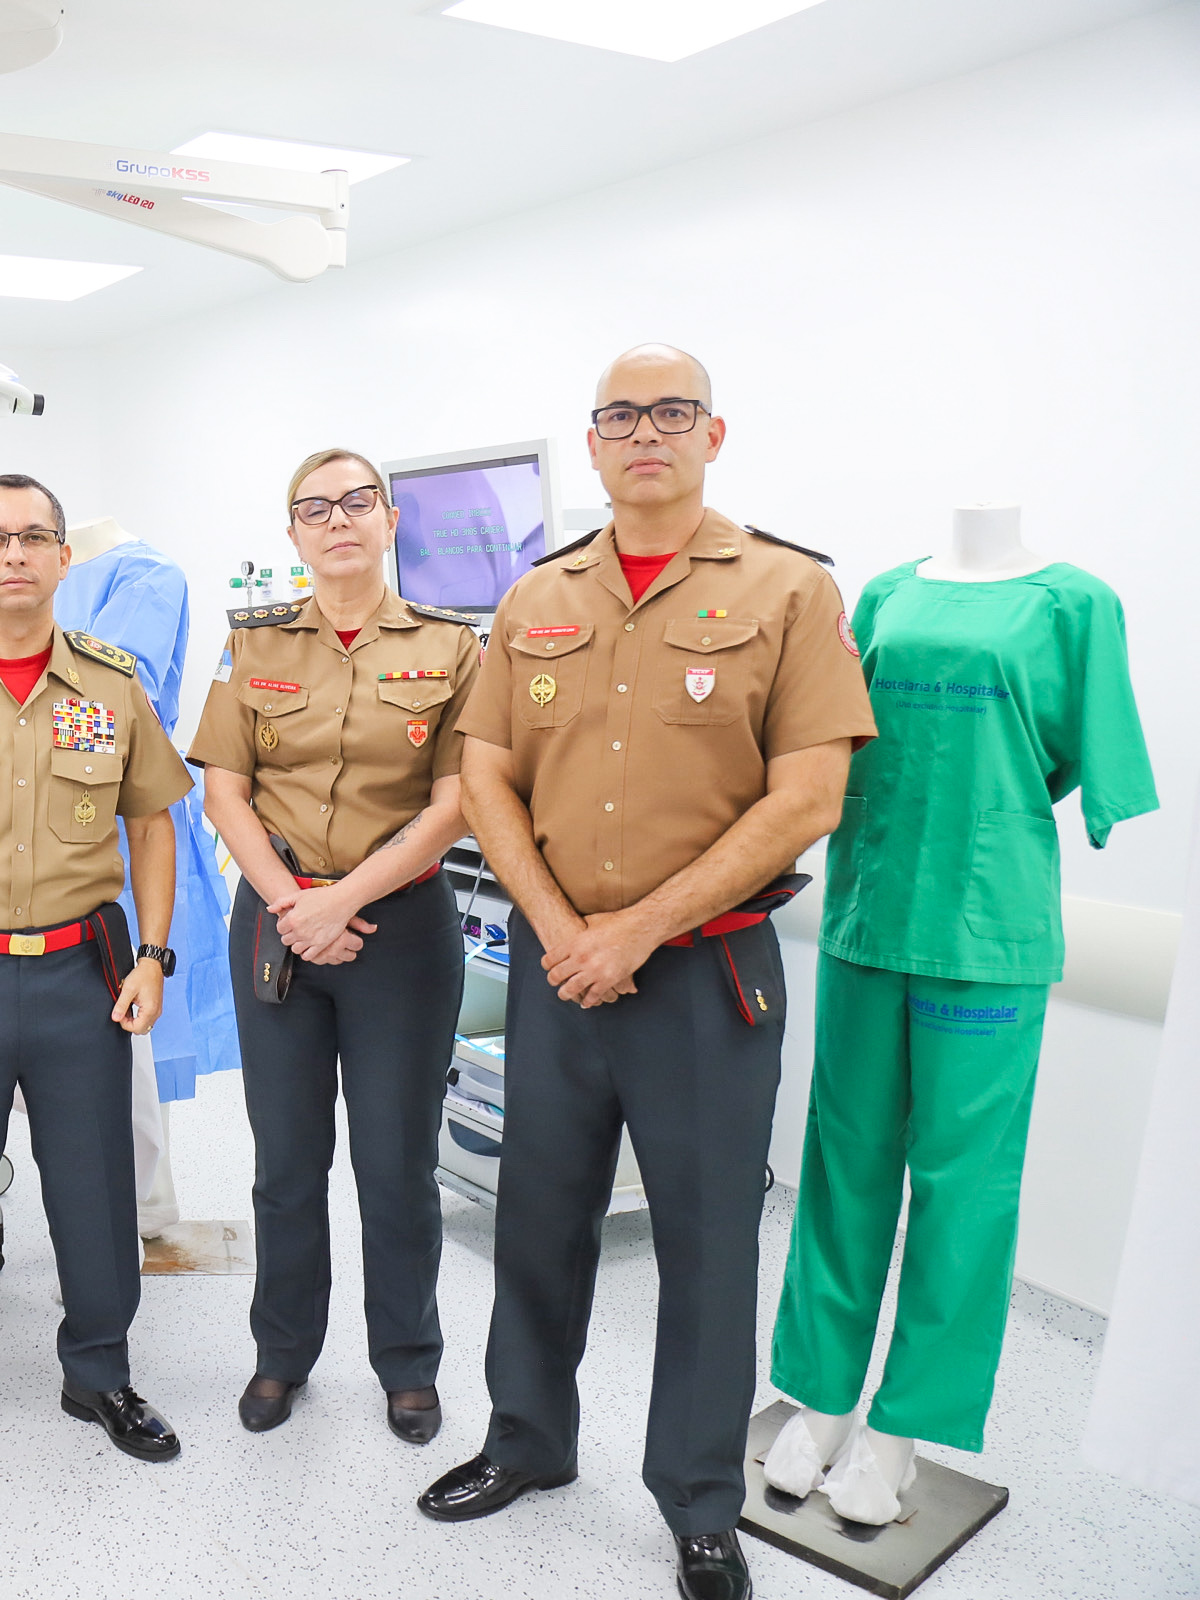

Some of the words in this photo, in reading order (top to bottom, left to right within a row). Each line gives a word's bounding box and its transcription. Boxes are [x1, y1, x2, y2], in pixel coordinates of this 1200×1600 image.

[116, 159, 210, 183] GrupoKSS
[140, 199, 155, 210] 120
[432, 530, 448, 538] TRUE
[480, 525, 505, 535] CAMERA
[466, 545, 483, 553] PARA
[875, 678, 930, 692] Hotelaria
[934, 681, 942, 692] &
[946, 682, 1010, 698] Hospitalar
[940, 1004, 950, 1016] &
[953, 1005, 1018, 1019] Hospitalar
